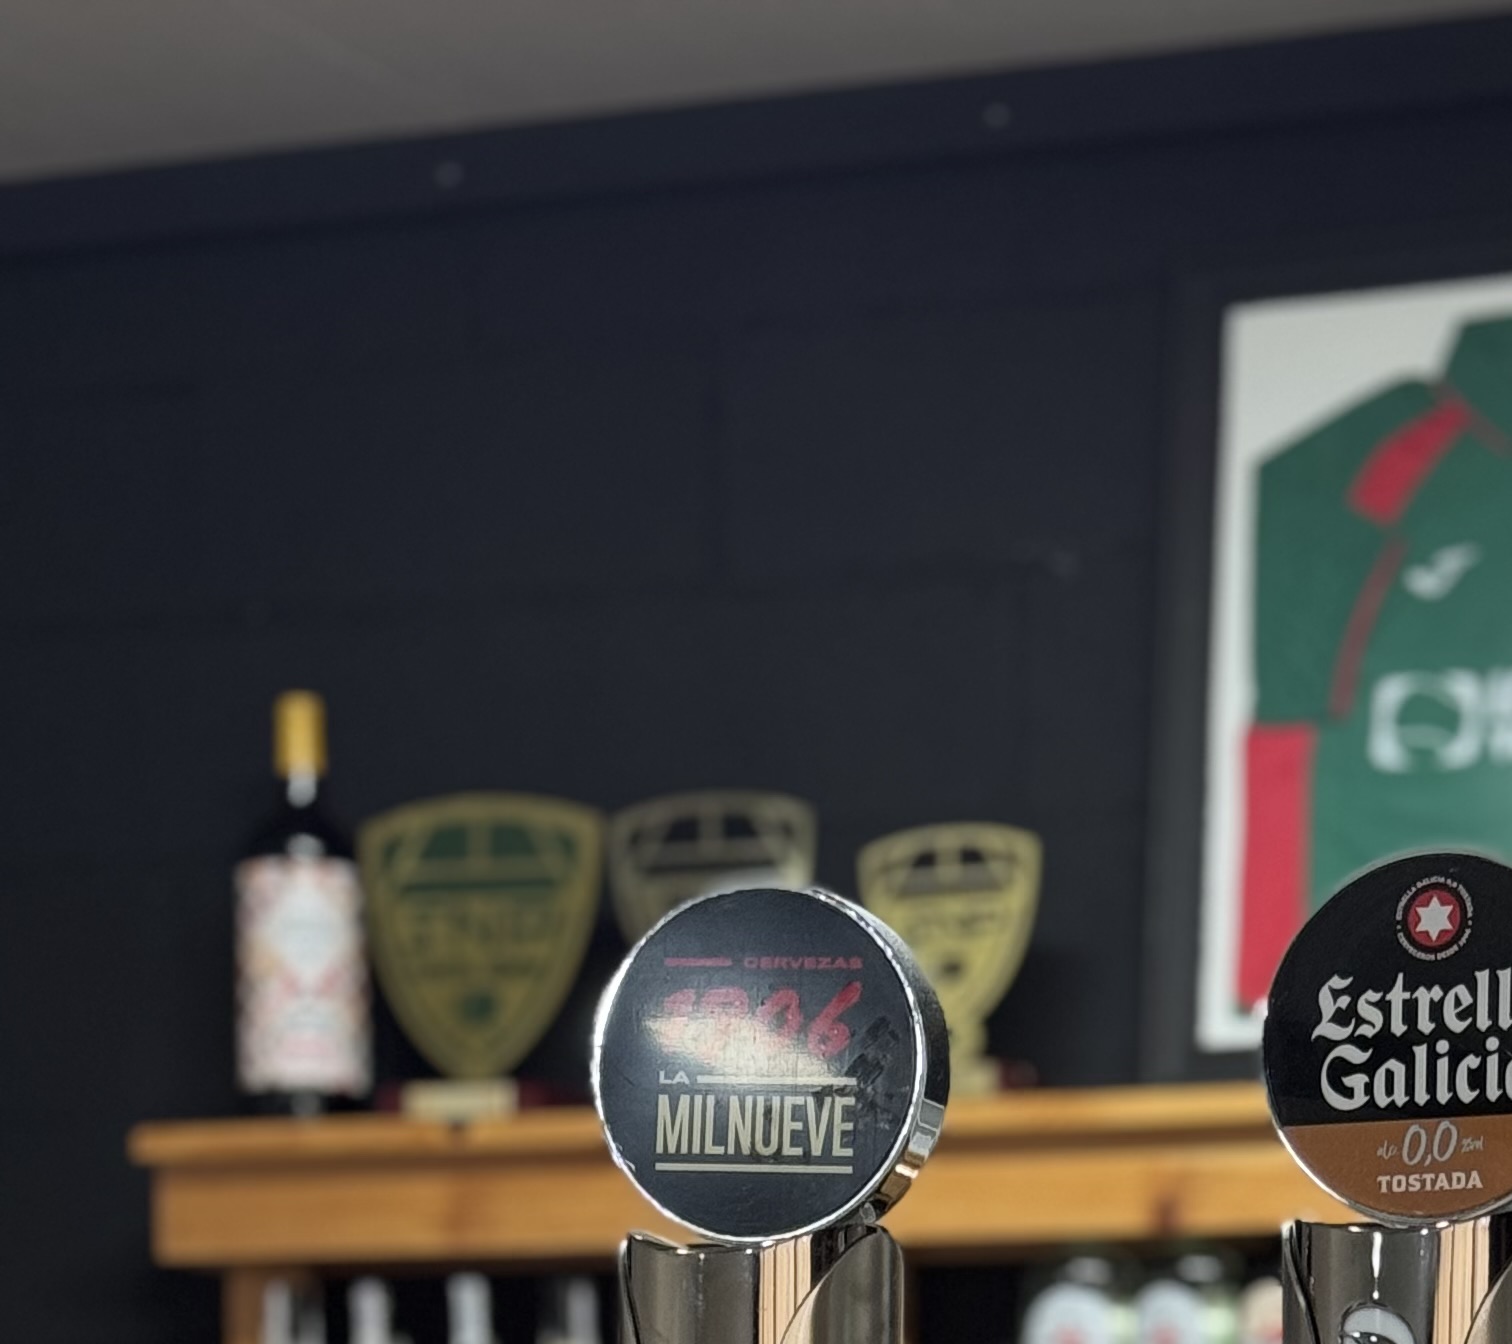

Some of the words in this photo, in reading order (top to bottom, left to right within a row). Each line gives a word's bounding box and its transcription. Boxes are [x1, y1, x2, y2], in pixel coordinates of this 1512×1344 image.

[744, 957, 863, 969] CERVEZAS
[659, 1070, 690, 1084] LA
[655, 1094, 856, 1156] MILNUEVE
[1377, 1170, 1483, 1193] TOSTADA
